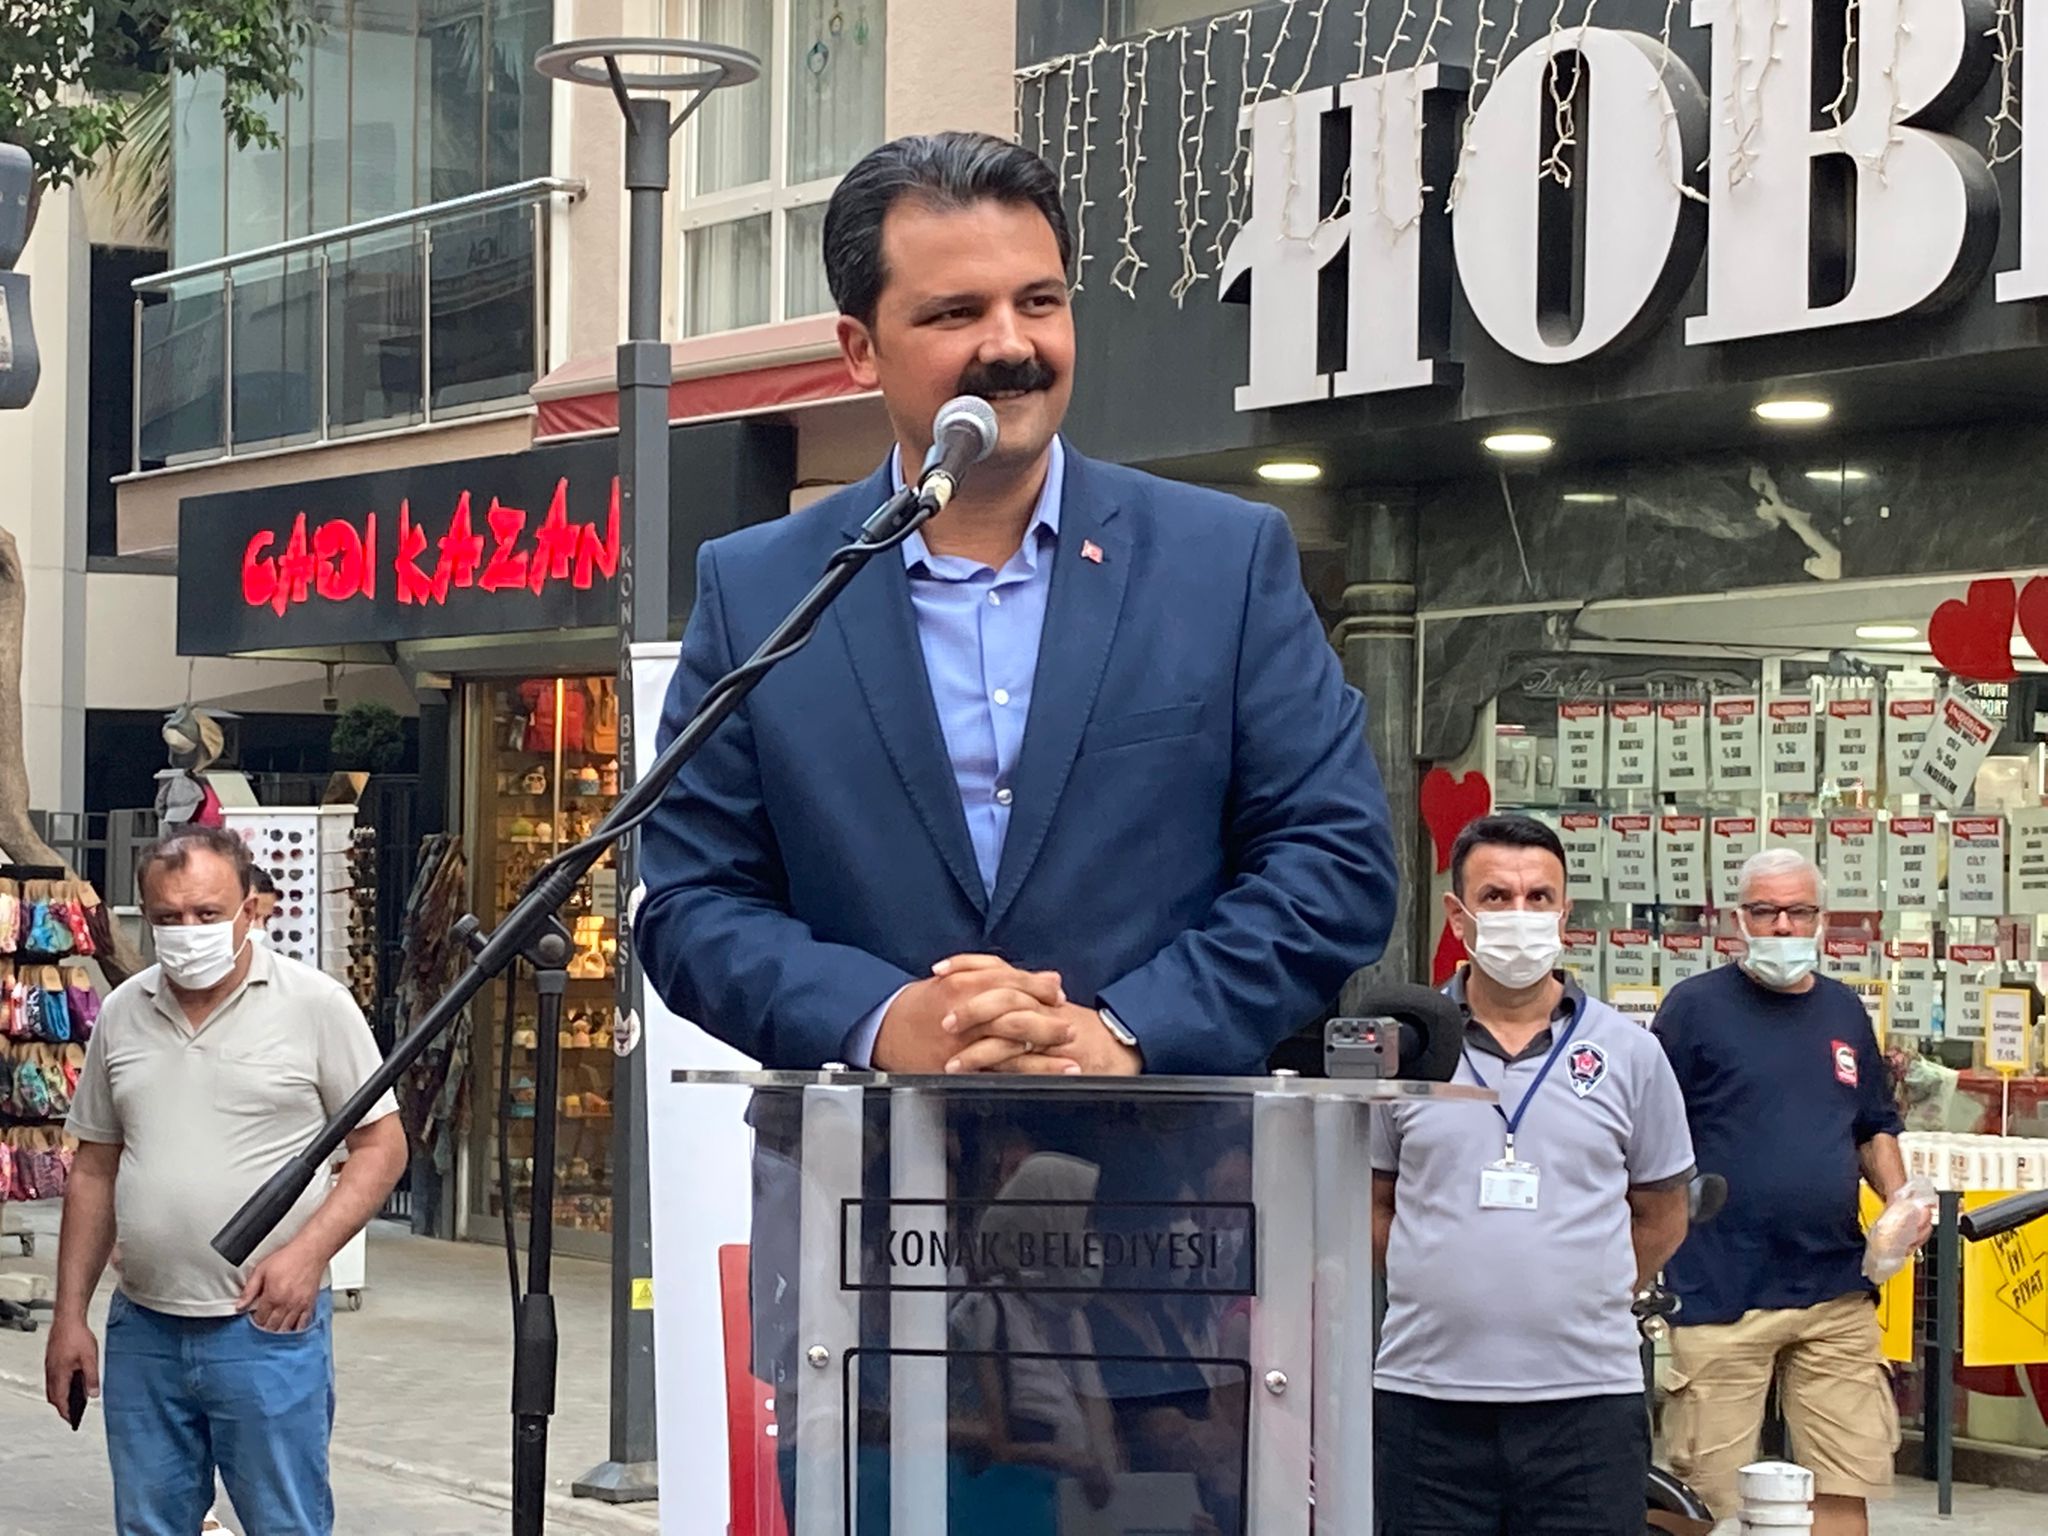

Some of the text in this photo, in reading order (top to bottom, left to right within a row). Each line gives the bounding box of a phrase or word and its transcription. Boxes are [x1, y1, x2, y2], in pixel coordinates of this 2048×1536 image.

[1218, 0, 2048, 412] HOB
[394, 474, 621, 607] KAZAN
[1978, 683, 2009, 698] YOUTH
[879, 1229, 998, 1268] KONAK
